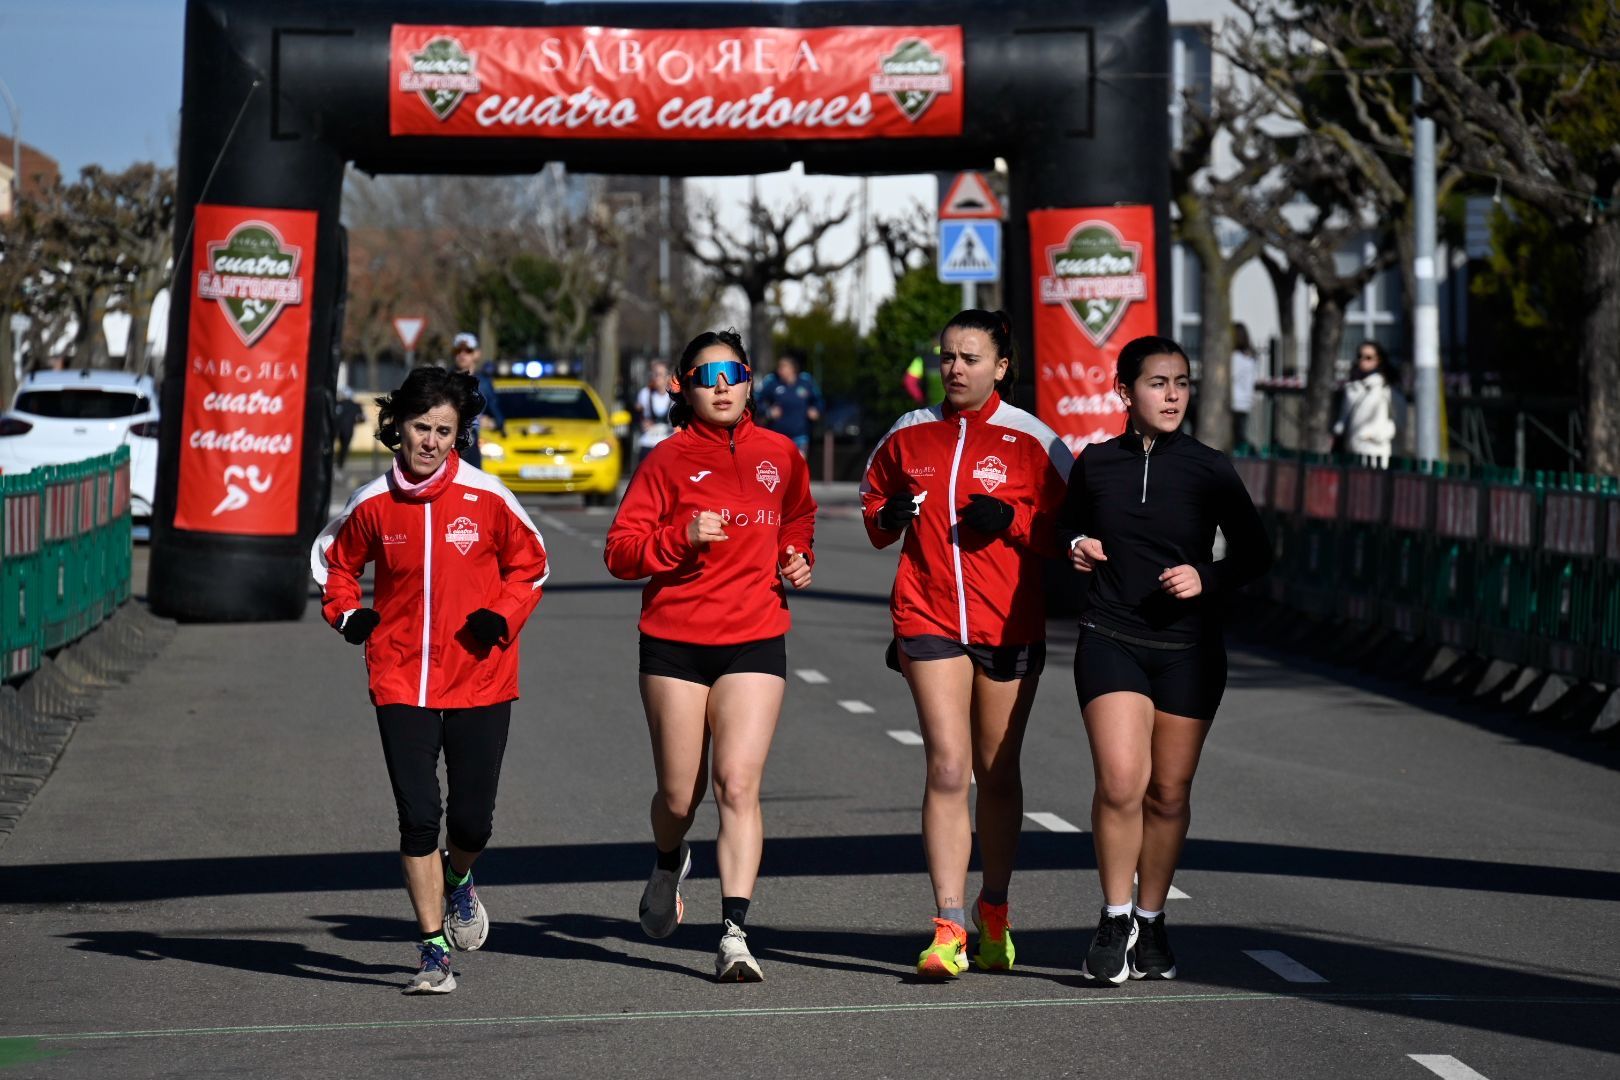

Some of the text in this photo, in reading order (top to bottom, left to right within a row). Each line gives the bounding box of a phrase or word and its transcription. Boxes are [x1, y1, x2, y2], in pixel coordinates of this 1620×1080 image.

[475, 85, 874, 129] cuatro cantones
[215, 255, 290, 275] cuatro
[1056, 253, 1132, 275] cuatro
[200, 274, 299, 301] CANTONES
[203, 389, 283, 414] cuatro
[190, 427, 293, 454] cantones
